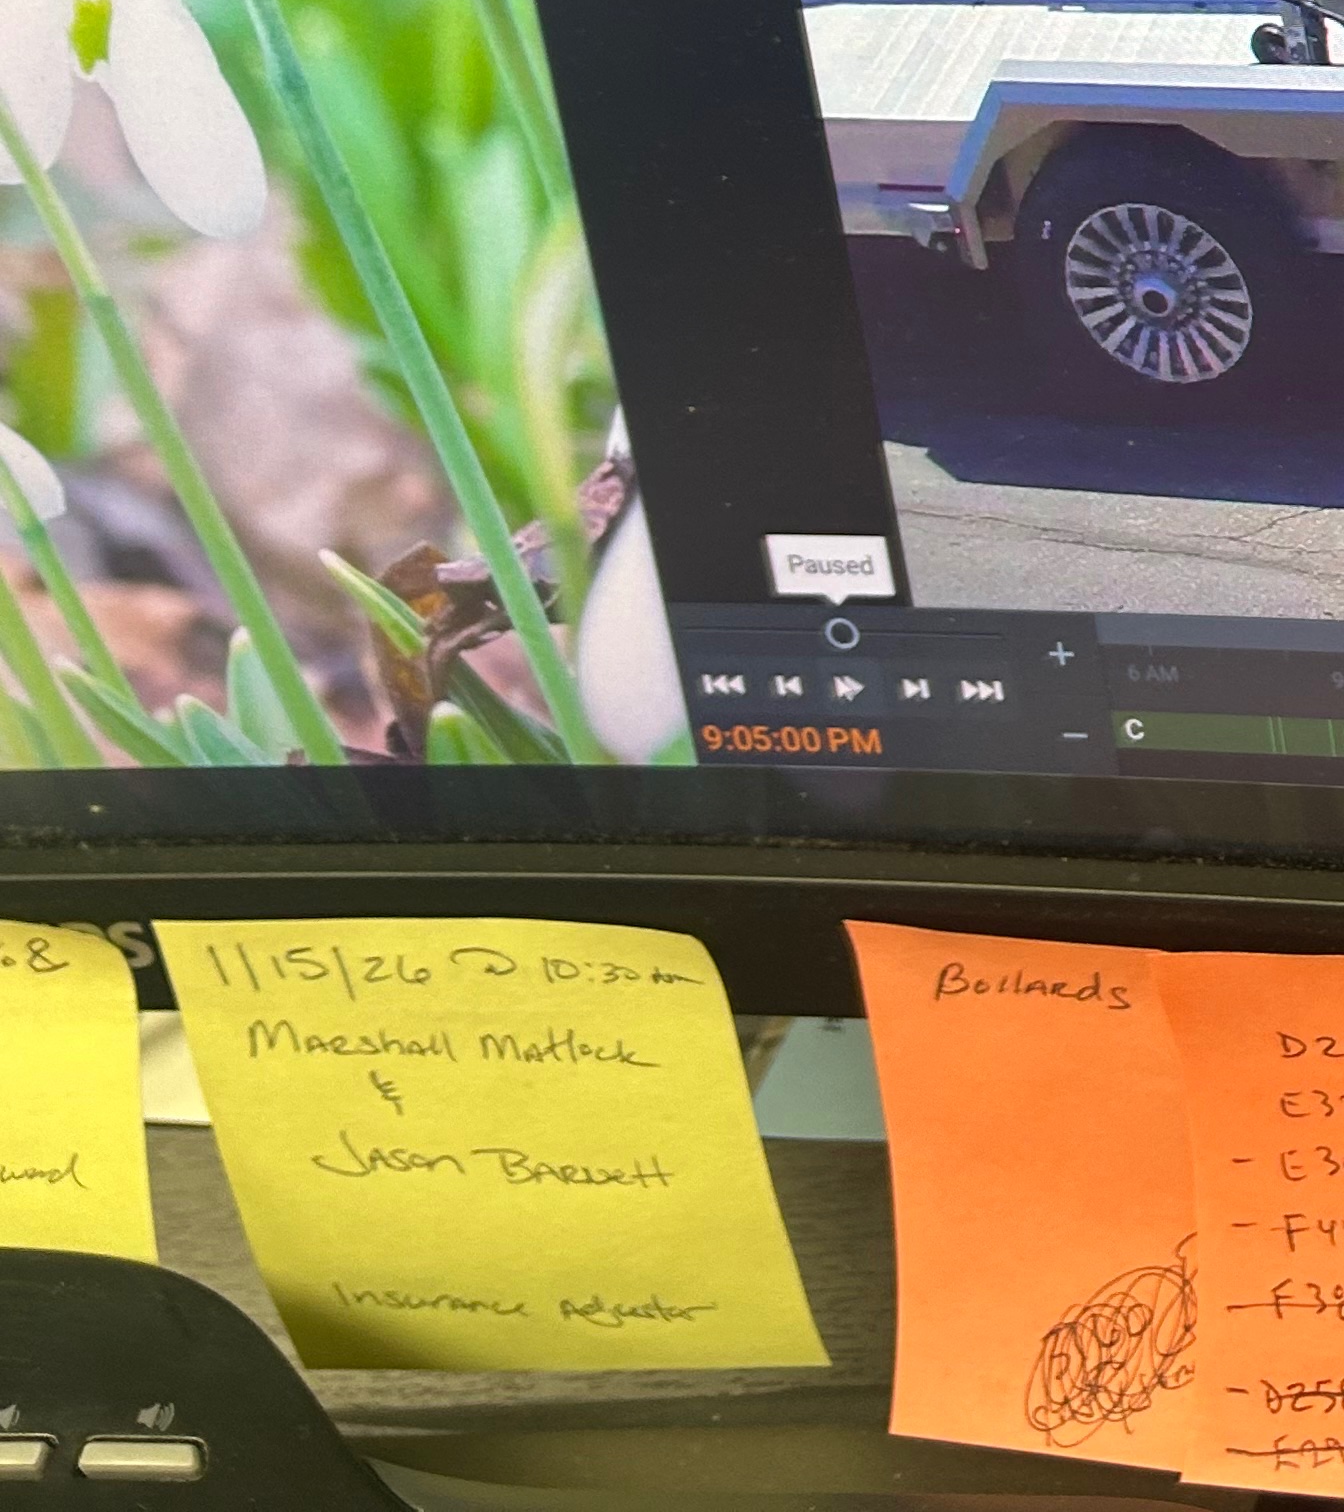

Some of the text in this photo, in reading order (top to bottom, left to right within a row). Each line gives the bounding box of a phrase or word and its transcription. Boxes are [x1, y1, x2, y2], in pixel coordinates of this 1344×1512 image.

[787, 553, 875, 576] Paused
[1144, 664, 1179, 683] AM
[702, 724, 883, 755] 9:05:00 PM
[1125, 717, 1145, 740] C
[206, 942, 433, 1002] 1/15/26
[540, 955, 642, 985] 10:30
